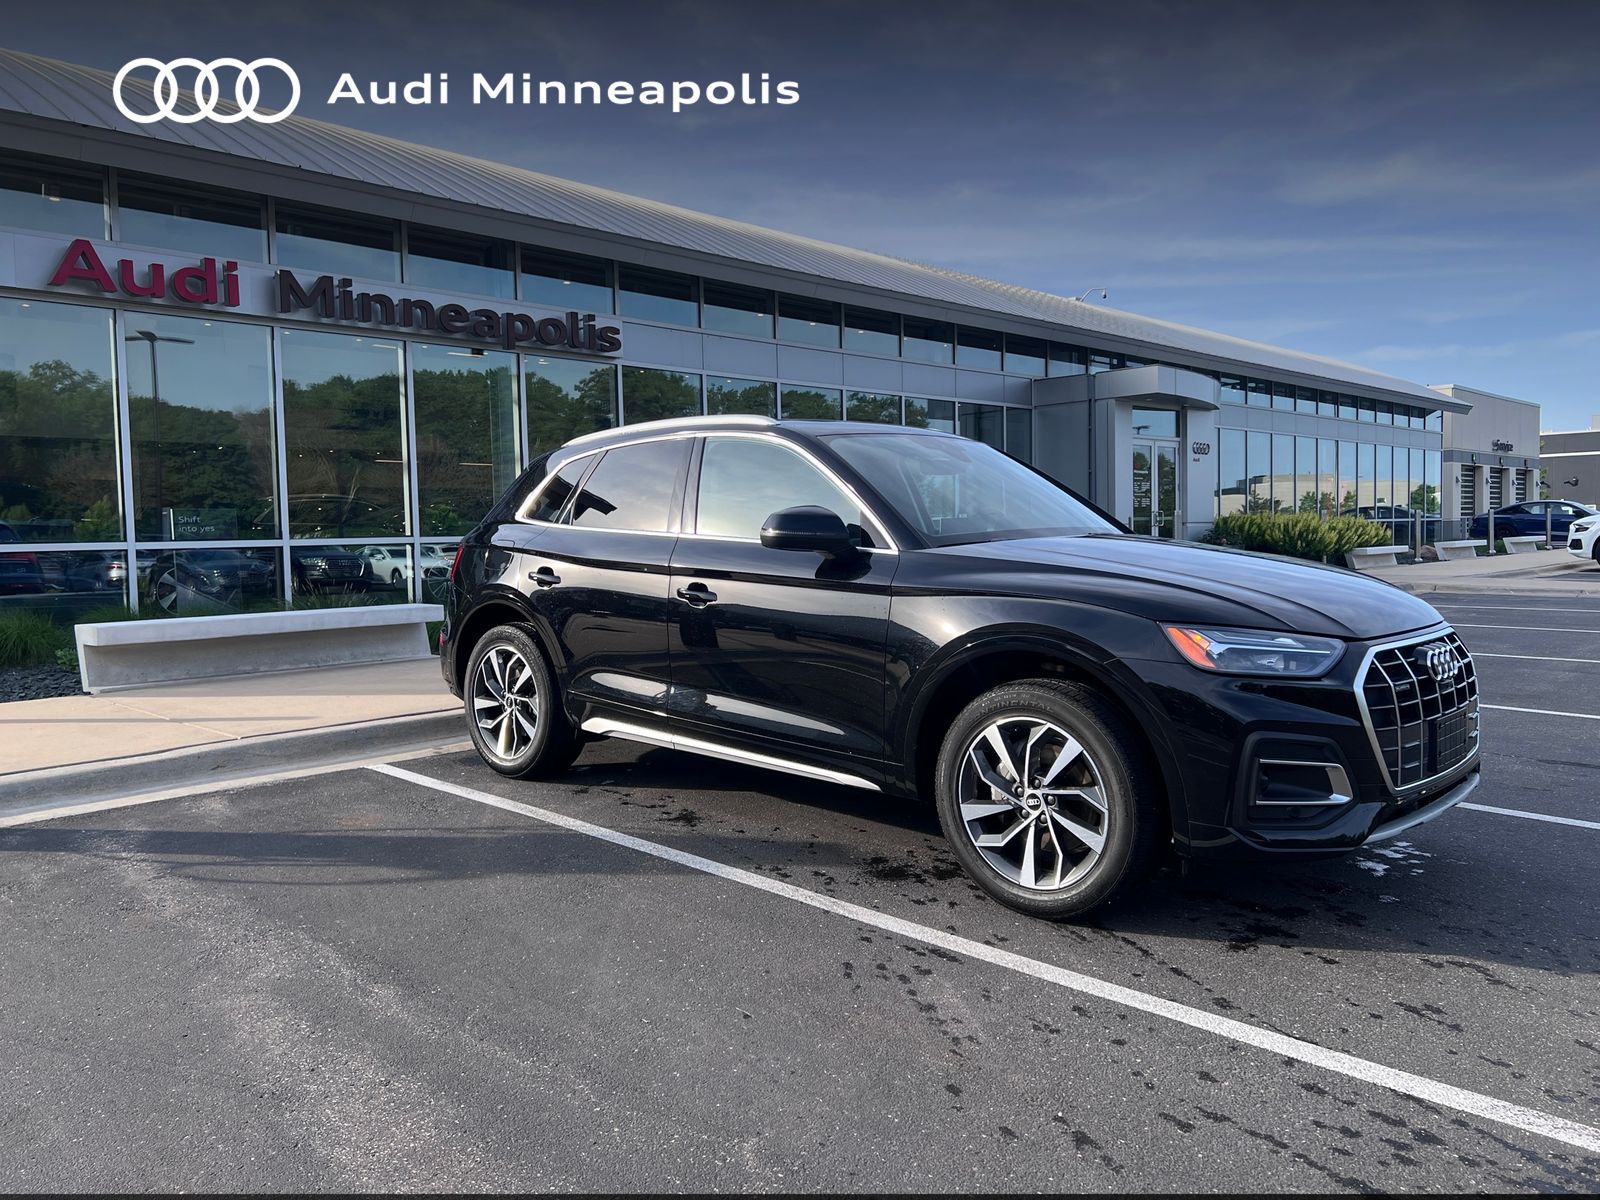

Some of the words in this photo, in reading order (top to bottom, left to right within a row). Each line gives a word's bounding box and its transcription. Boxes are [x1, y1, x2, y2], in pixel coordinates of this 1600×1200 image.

[48, 238, 240, 308] Audi
[272, 268, 623, 353] Minneapolis
[178, 515, 201, 524] Shift
[200, 525, 215, 534] yes
